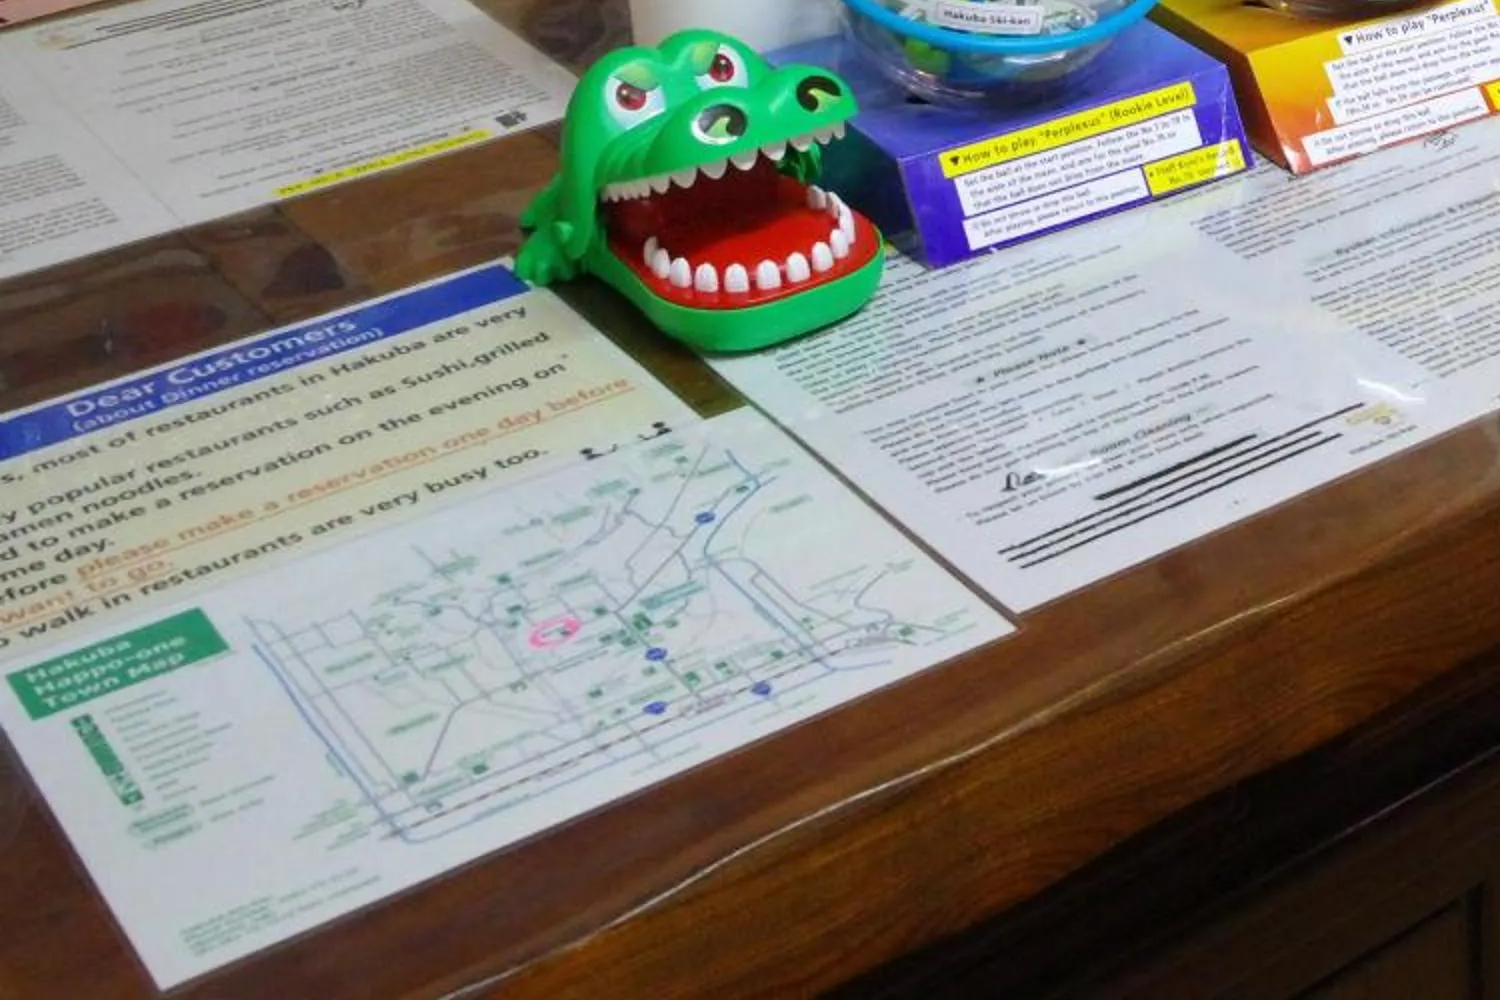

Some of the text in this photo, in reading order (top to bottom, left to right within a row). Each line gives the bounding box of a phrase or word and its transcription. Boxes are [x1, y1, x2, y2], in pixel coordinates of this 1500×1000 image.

[1355, 30, 1383, 44] How
[1386, 26, 1398, 37] to
[1402, 19, 1425, 36] play
[961, 151, 991, 164] How
[994, 144, 1009, 155] to
[1011, 136, 1036, 153] play
[32, 306, 527, 475] most of restaurants in Hakuba are very
[66, 318, 357, 418] Dear Customers
[72, 326, 385, 433] (about Dinner reservation)
[27, 467, 137, 516] popular
[146, 416, 298, 473] restaurants
[303, 396, 363, 421] such
[368, 385, 397, 401] as
[27, 362, 568, 552] to make a reservation on the evening on
[0, 376, 633, 602] fore please make a reservation one day before
[0, 469, 203, 544] amen noodles.
[0, 537, 116, 583] me day.
[19, 605, 97, 640] walk
[102, 591, 132, 609] in
[139, 532, 303, 597] restaurants
[309, 513, 354, 537] are
[358, 489, 421, 518] very
[424, 464, 489, 494] busy
[493, 448, 549, 471] too.
[0, 558, 175, 626] want to go.
[25, 640, 132, 684] Hakuba
[33, 632, 188, 698] Happo-one
[42, 652, 185, 709] Town Map
